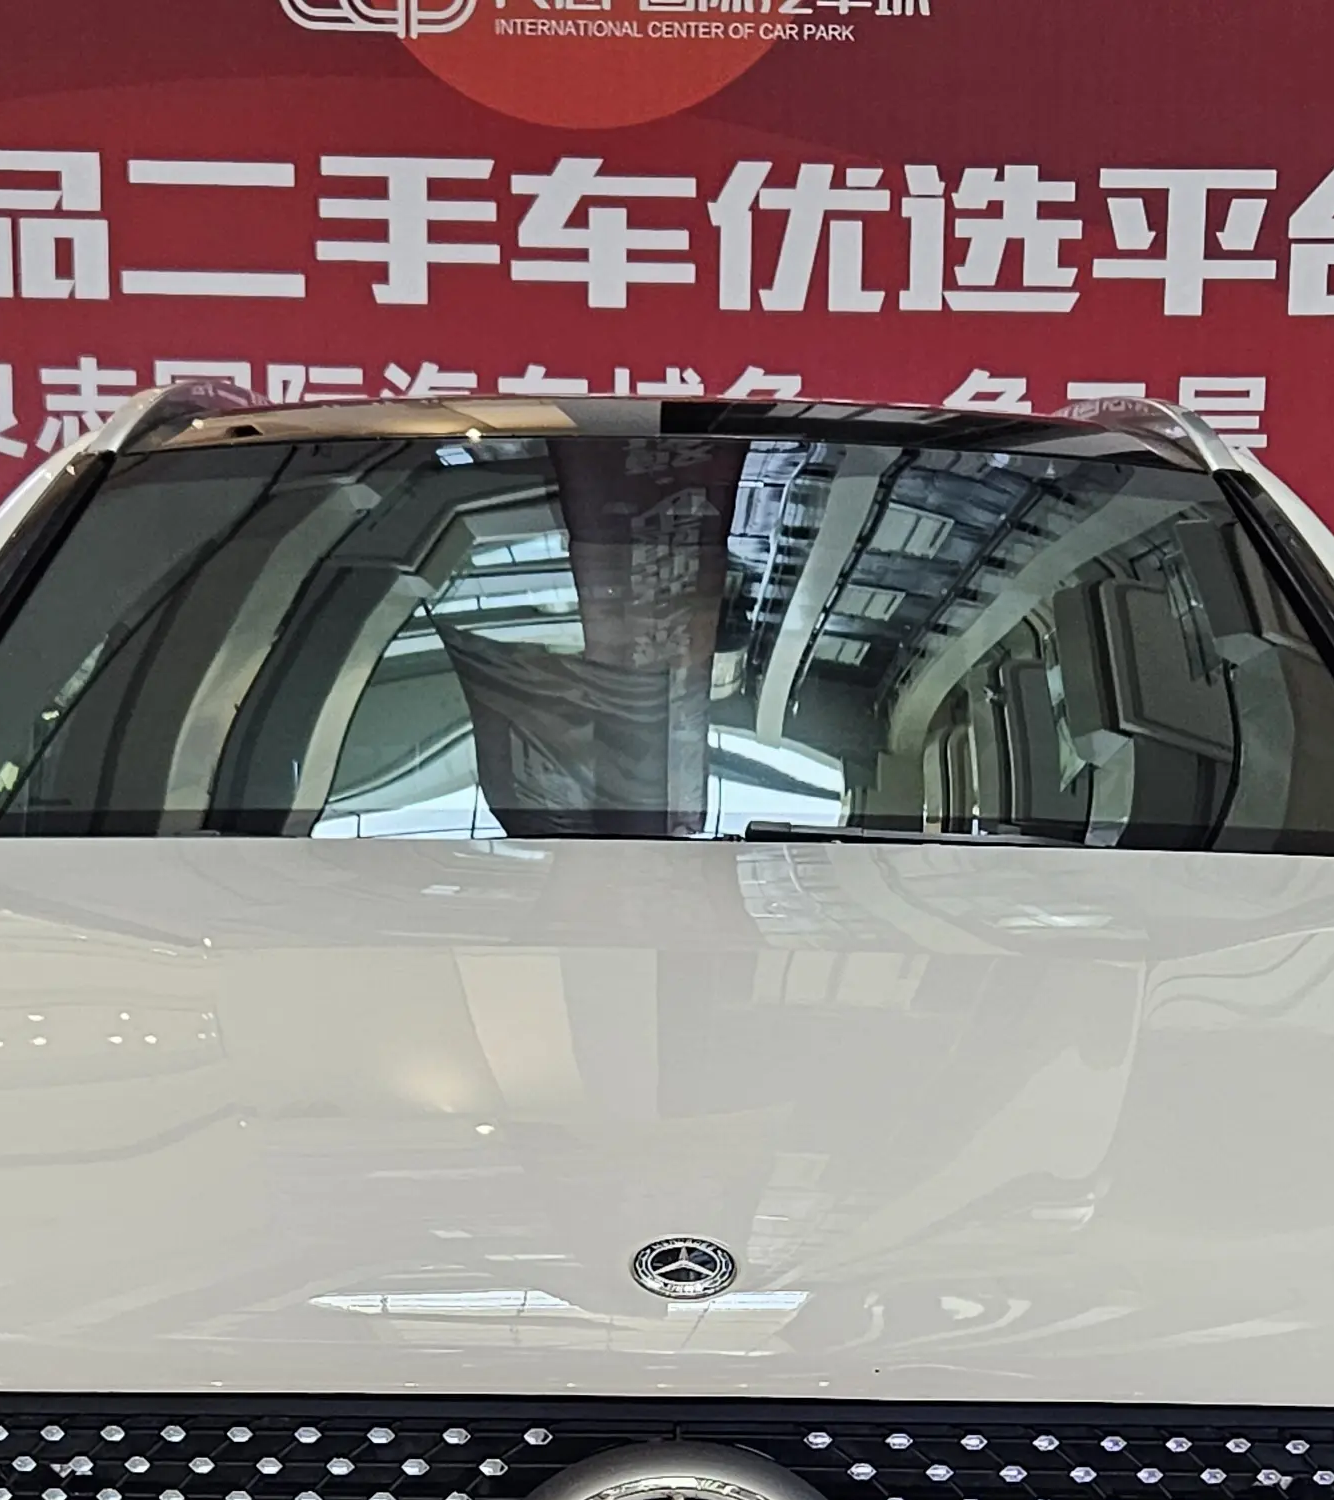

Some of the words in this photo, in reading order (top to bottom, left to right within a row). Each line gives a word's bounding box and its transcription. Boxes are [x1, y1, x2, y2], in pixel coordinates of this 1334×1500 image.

[495, 18, 643, 38] INTERNATIONAL
[647, 21, 725, 39] CENTER
[727, 22, 756, 39] OF
[758, 23, 800, 41] CAR
[802, 24, 855, 42] PARK
